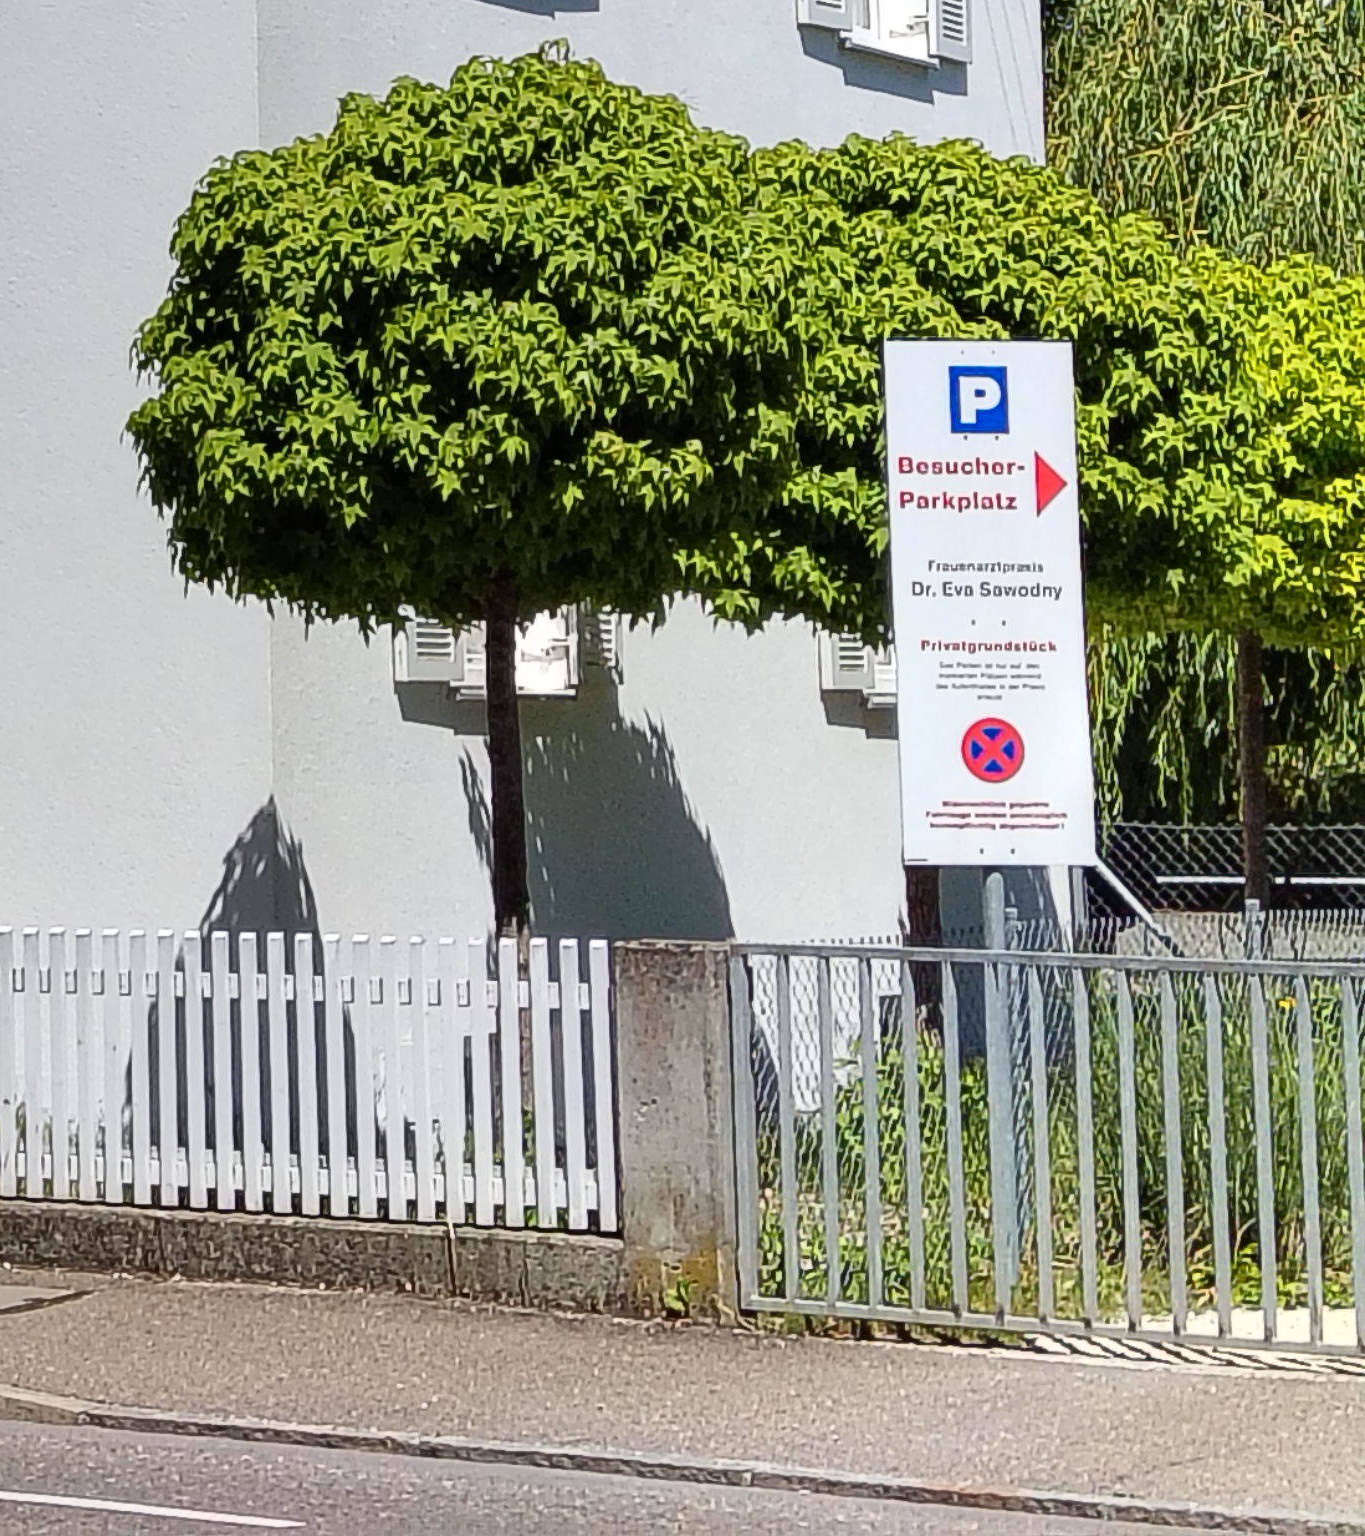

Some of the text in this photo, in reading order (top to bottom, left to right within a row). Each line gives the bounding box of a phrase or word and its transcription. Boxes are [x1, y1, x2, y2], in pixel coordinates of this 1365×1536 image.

[958, 375, 1002, 424] P
[898, 456, 1025, 476] Besucher-
[899, 491, 1018, 513] Parkplatz
[928, 560, 1044, 574] Frauenarztpraxis
[911, 581, 1063, 601] Dr. Eva Sawodny
[920, 639, 1057, 654] Privatgrundstück
